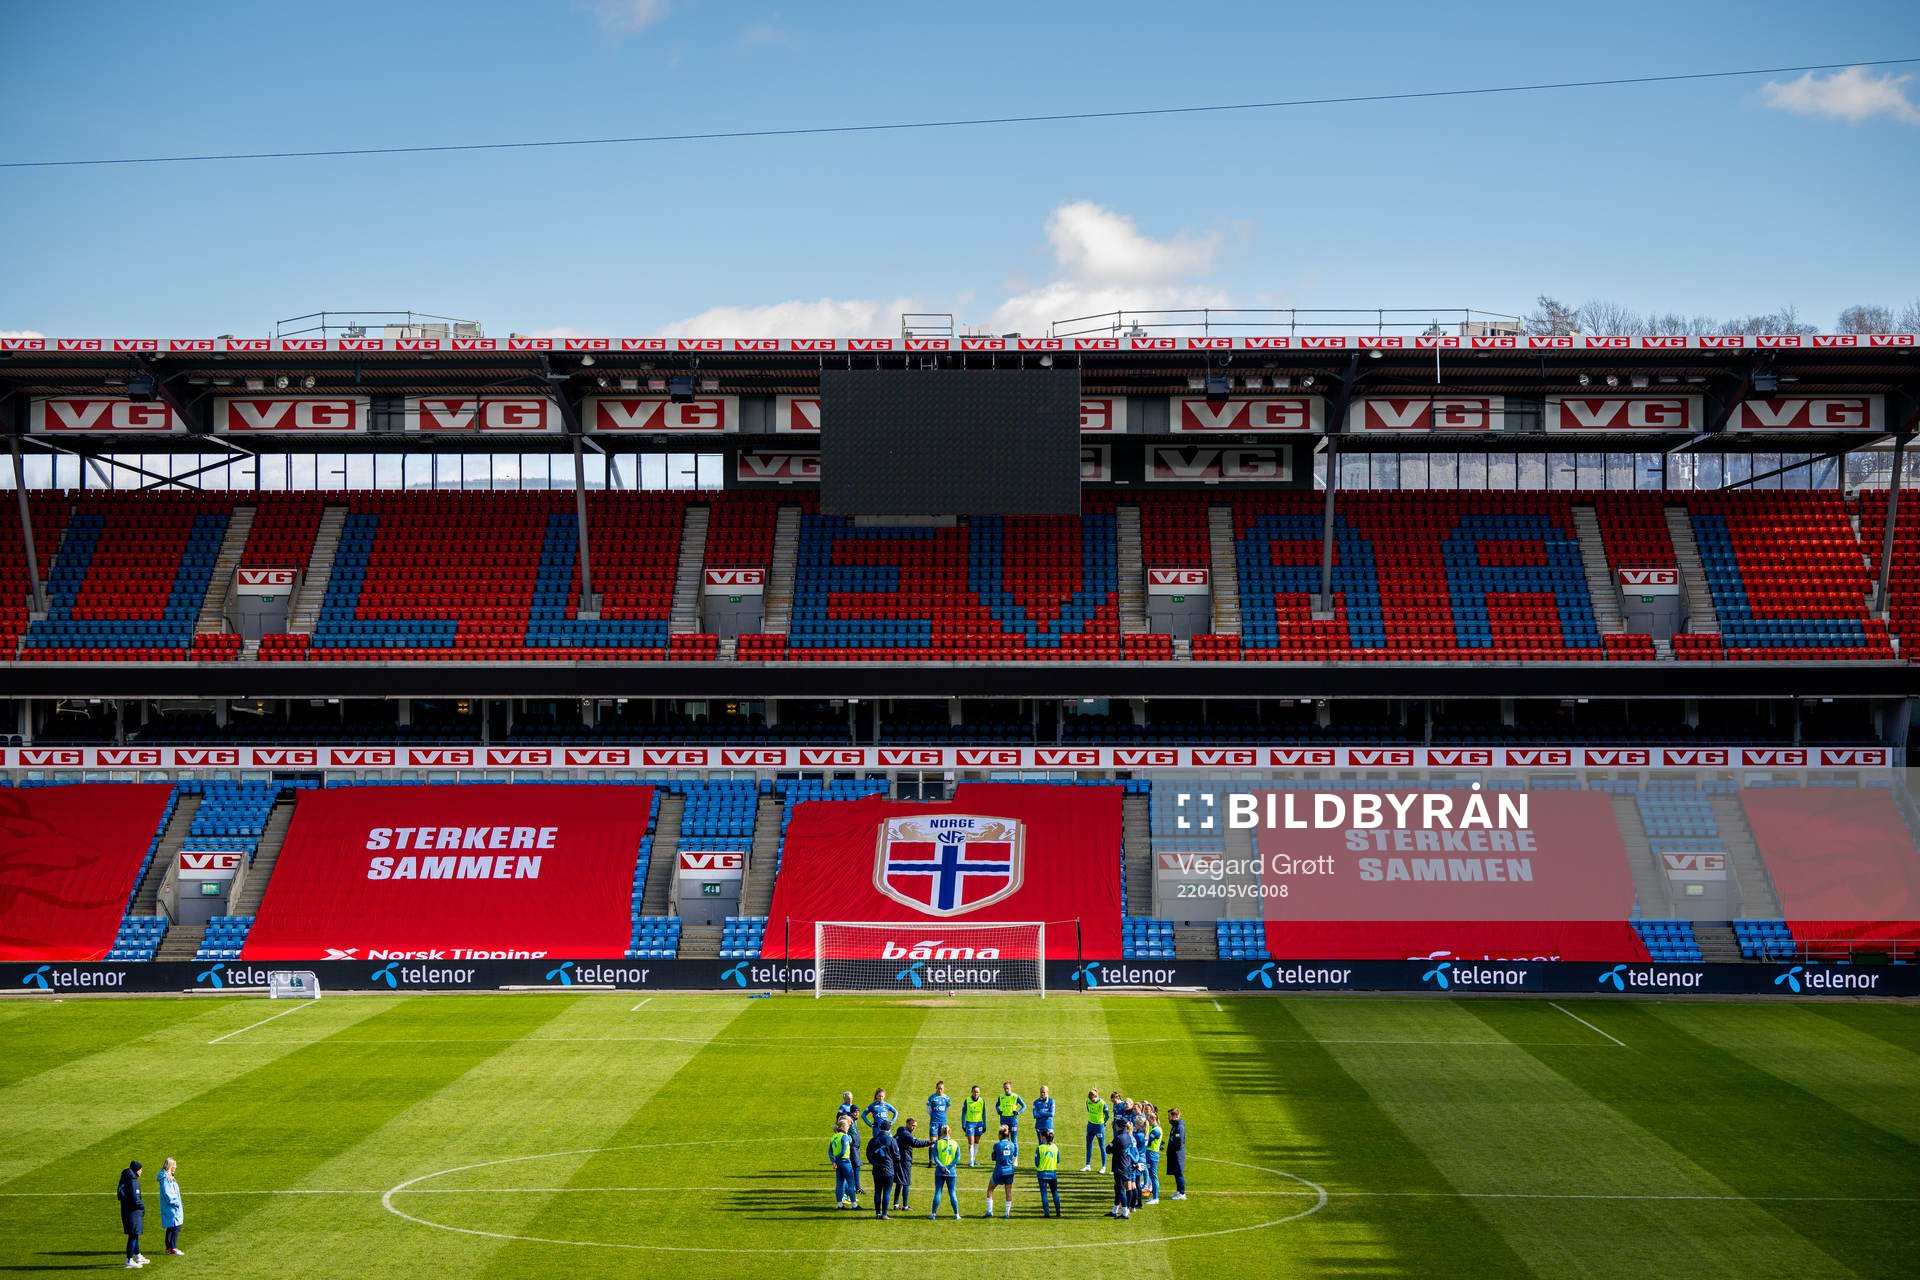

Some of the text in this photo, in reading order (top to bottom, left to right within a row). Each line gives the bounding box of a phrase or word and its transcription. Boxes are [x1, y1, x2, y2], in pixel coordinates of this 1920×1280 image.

[3, 336, 1912, 350] VG VG VG VG VG VG VG VG VG VG VG VG VG VG VG VG VG VG VG VG VG VG VG VG VG VG VG VG VG VG VG VG VG VG
[49, 402, 165, 428] VG
[232, 402, 350, 428] VG
[423, 402, 540, 428] VG
[600, 402, 718, 428] VG
[1185, 401, 1303, 428] VG
[1368, 401, 1482, 427] VG
[1563, 401, 1682, 427] VG
[1744, 400, 1863, 426] VG
[743, 456, 820, 475] VG
[1157, 450, 1276, 476] VG
[240, 571, 292, 584] VG
[707, 571, 760, 584] VG
[1150, 571, 1204, 584] VG
[1621, 571, 1676, 584] VG
[22, 750, 1882, 764] VG VG VG VG VG VG VG VG VG VG VG VG VG VG VG VG VG VG VG VG VG VG VG VG
[930, 819, 975, 829] NORGE
[366, 827, 558, 850] STERKERE
[1345, 830, 1537, 852] STERKERE
[182, 854, 241, 868] VG
[367, 856, 542, 880] SAMMEN
[681, 854, 741, 868] VG
[1359, 858, 1533, 881] SAMMEN
[1664, 855, 1724, 869] VG
[368, 949, 446, 960] Norsk
[52, 967, 126, 986] telenor
[401, 965, 475, 984] telenor
[576, 965, 649, 984] telenor
[751, 964, 824, 983] teleno
[926, 965, 1000, 983] telenor
[1101, 965, 1176, 984] telenor
[1278, 965, 1352, 984] telenor
[1452, 966, 1527, 985] telenor
[1628, 968, 1703, 987] telenor
[1804, 969, 1879, 989] telenor
